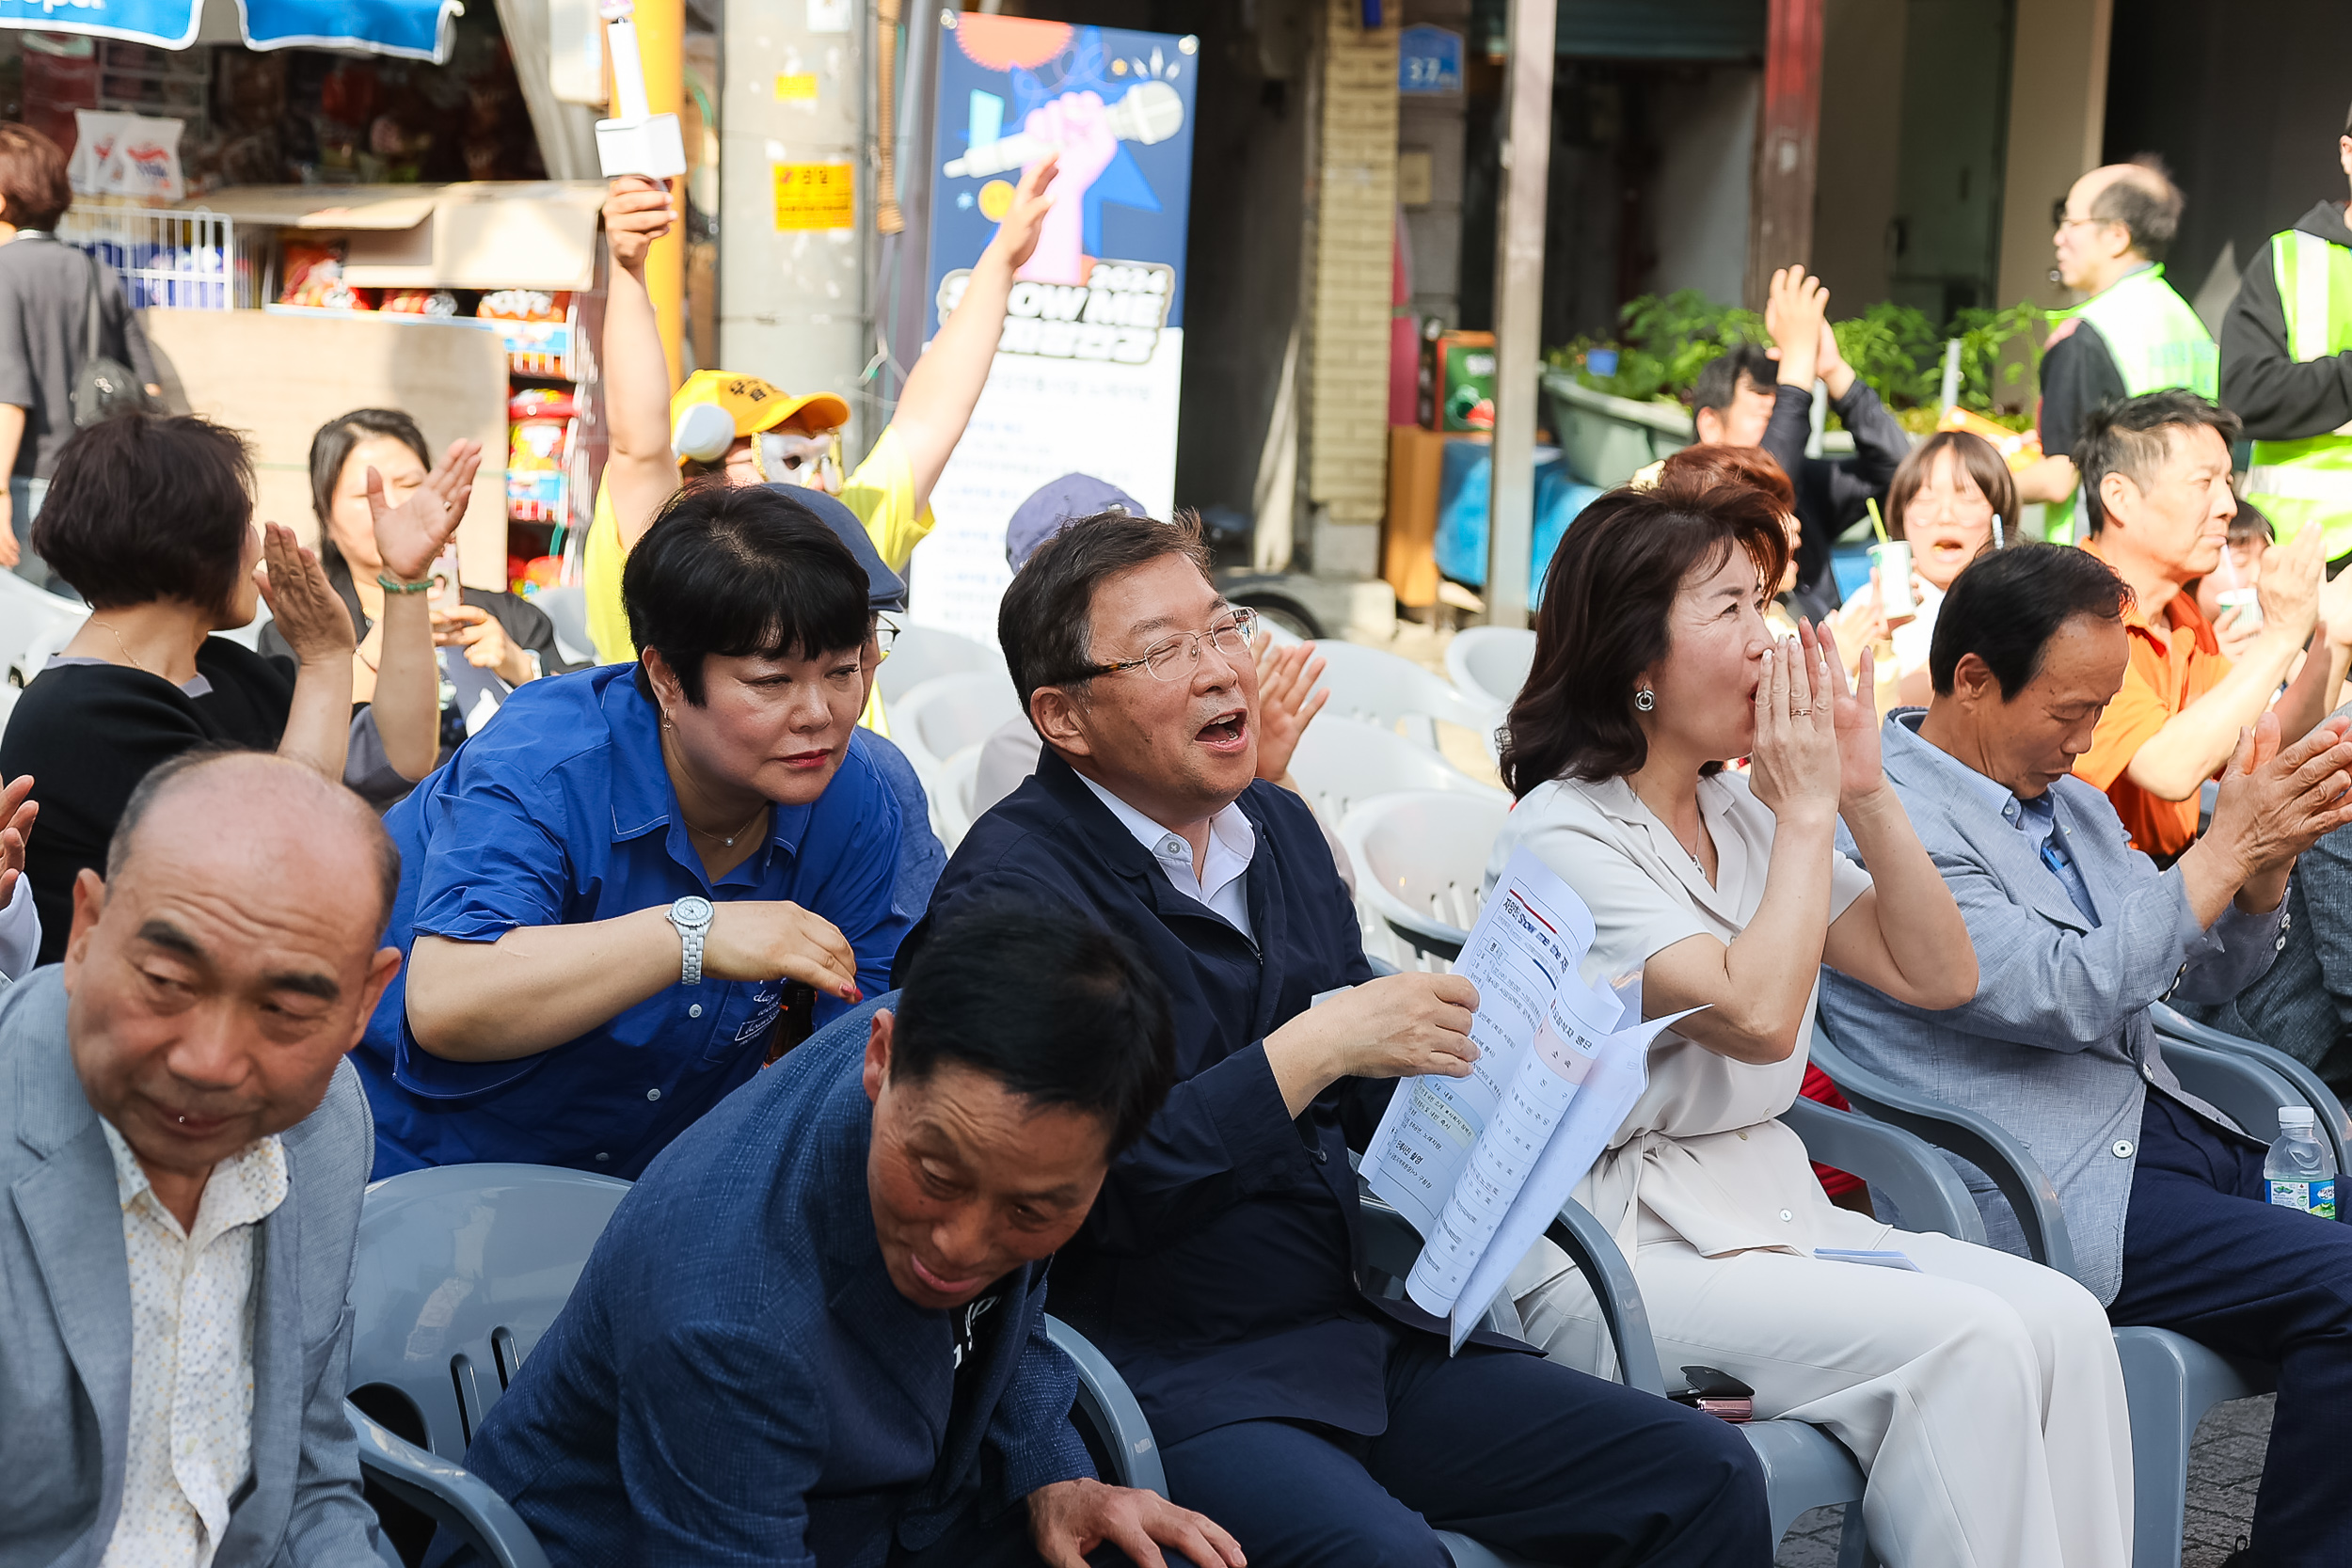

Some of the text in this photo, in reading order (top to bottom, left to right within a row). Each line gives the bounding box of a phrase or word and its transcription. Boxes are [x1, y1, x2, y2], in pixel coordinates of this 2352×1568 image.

[1089, 263, 1168, 293] 2024
[1082, 289, 1165, 328] ME
[1575, 1035, 1593, 1051] 명단
